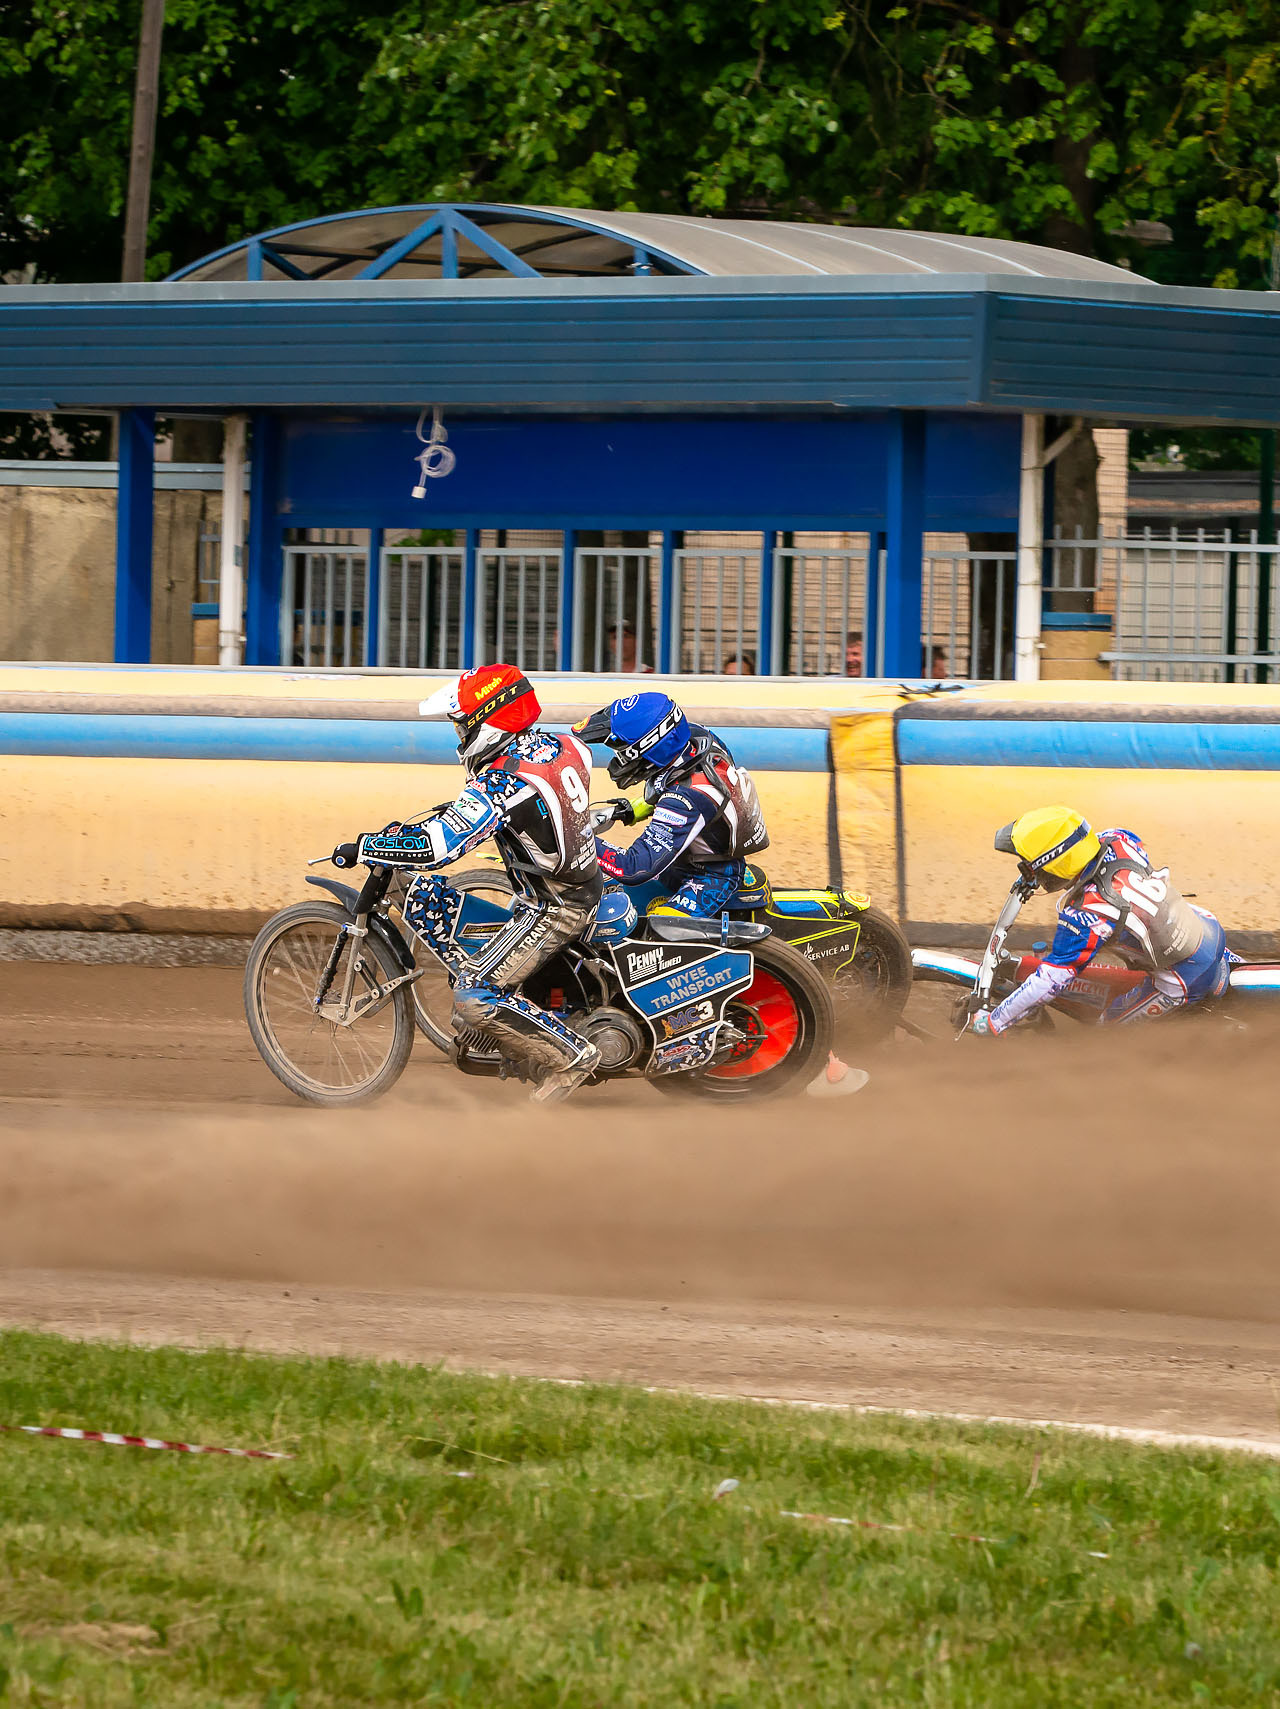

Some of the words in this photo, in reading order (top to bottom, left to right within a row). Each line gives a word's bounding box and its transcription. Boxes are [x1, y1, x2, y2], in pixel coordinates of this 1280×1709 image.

[475, 676, 503, 701] Mitch
[467, 685, 518, 729] SCOTT
[560, 765, 589, 814] 9
[363, 850, 404, 858] PROPERTY
[407, 850, 433, 858] GROUP
[364, 837, 427, 850] KOSLOW
[1031, 842, 1065, 870] SCOTT
[1120, 869, 1168, 918] 16
[490, 949, 523, 981] WYEE
[627, 946, 664, 974] PENNY
[807, 946, 838, 961] SERVICE
[839, 944, 850, 953] AB
[650, 967, 732, 1009] TRANSPORT
[666, 965, 709, 990] WYEE
